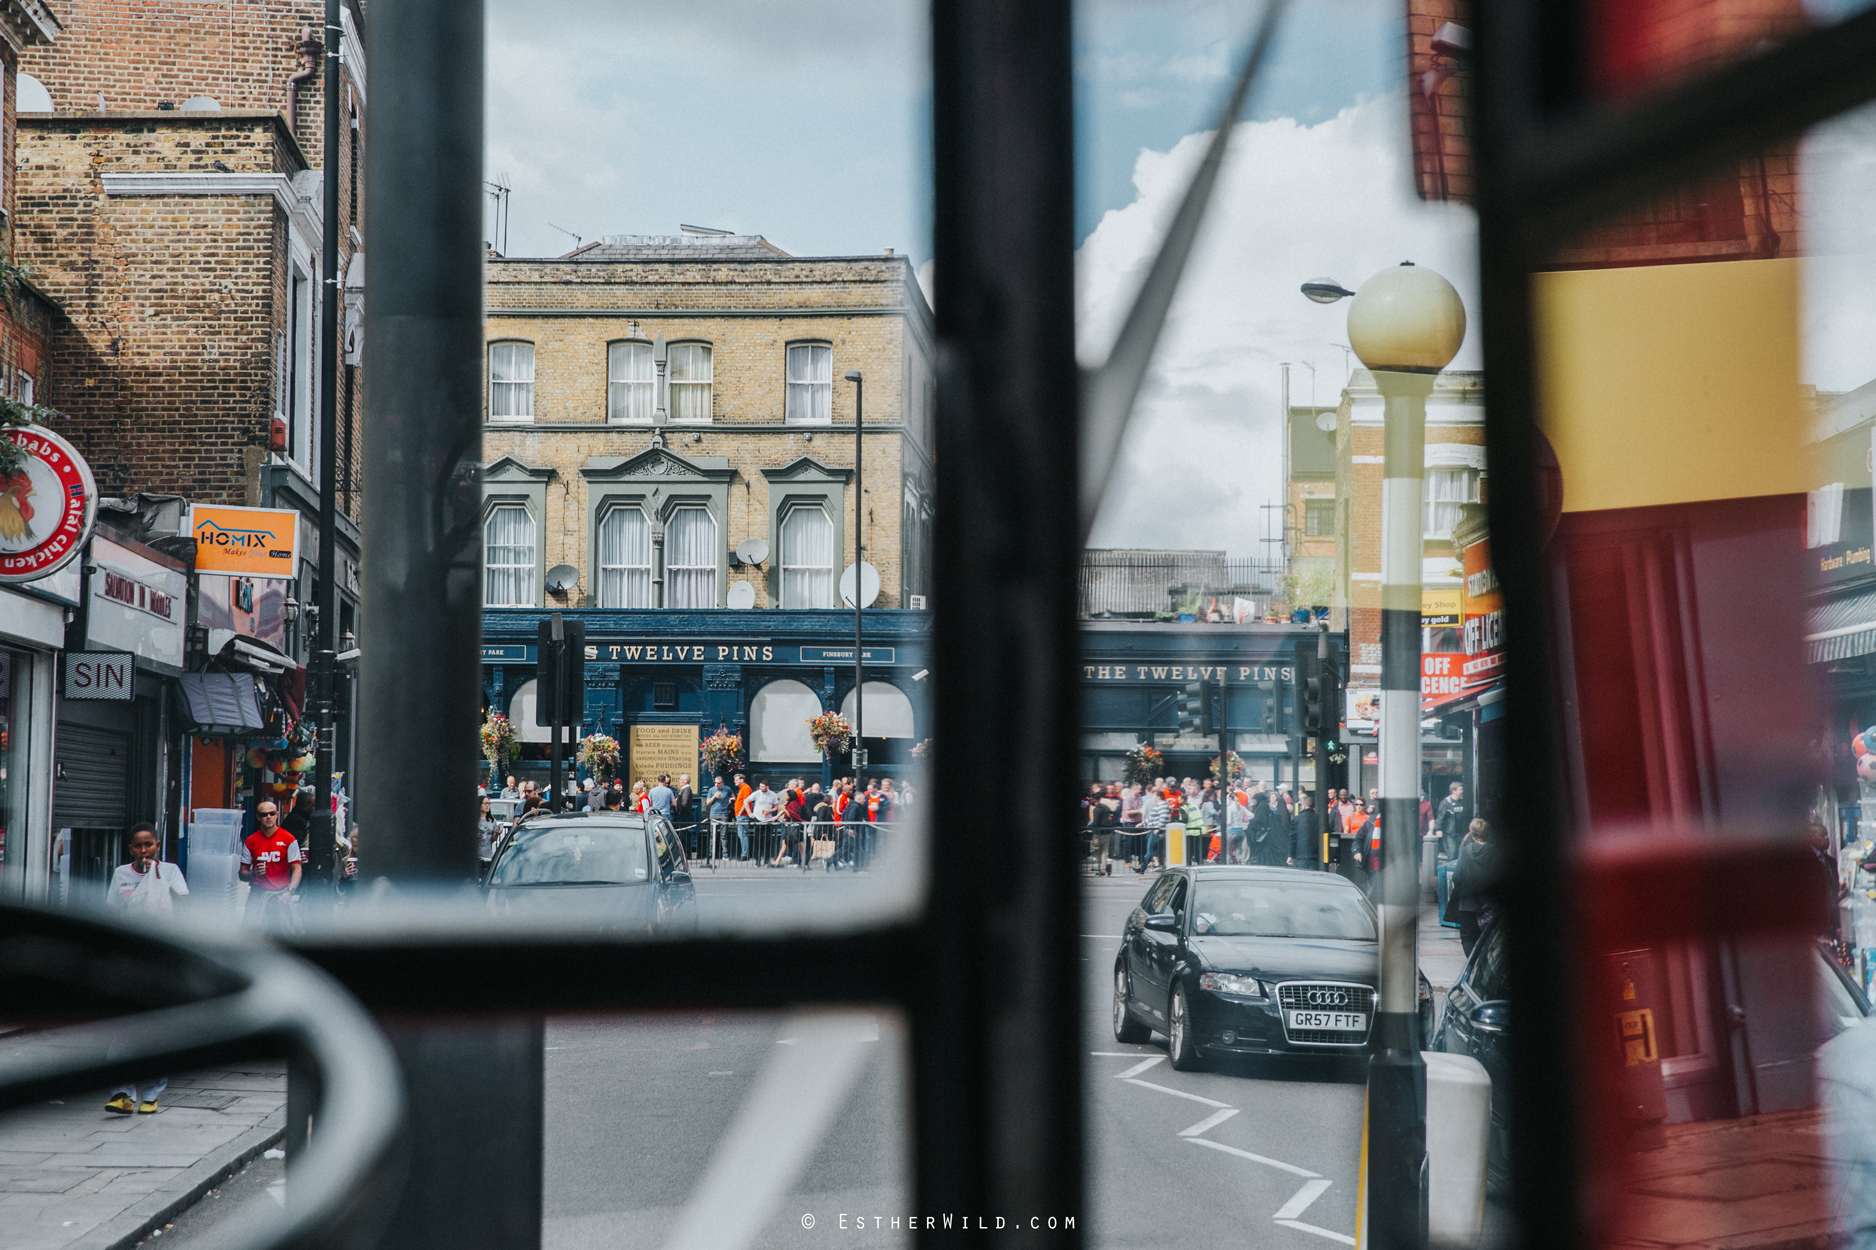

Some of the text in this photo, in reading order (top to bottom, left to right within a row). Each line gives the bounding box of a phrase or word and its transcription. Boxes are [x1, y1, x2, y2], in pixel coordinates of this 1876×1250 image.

[4, 483, 84, 568] Halal chicken
[201, 531, 266, 548] HOMIX
[223, 548, 247, 556] Makes
[249, 549, 267, 557] Your
[1846, 546, 1870, 565] Plumbing
[1422, 601, 1456, 610] ey Shop
[1431, 615, 1449, 625] gold
[1464, 617, 1480, 656] OFF
[609, 645, 705, 661] TWELVE
[718, 646, 773, 661] PINS
[1084, 666, 1126, 679] THE
[1239, 667, 1291, 680] PINS
[1424, 657, 1451, 675] OFF
[74, 662, 124, 688] SIN
[1295, 1012, 1360, 1028] GR57 FTF
